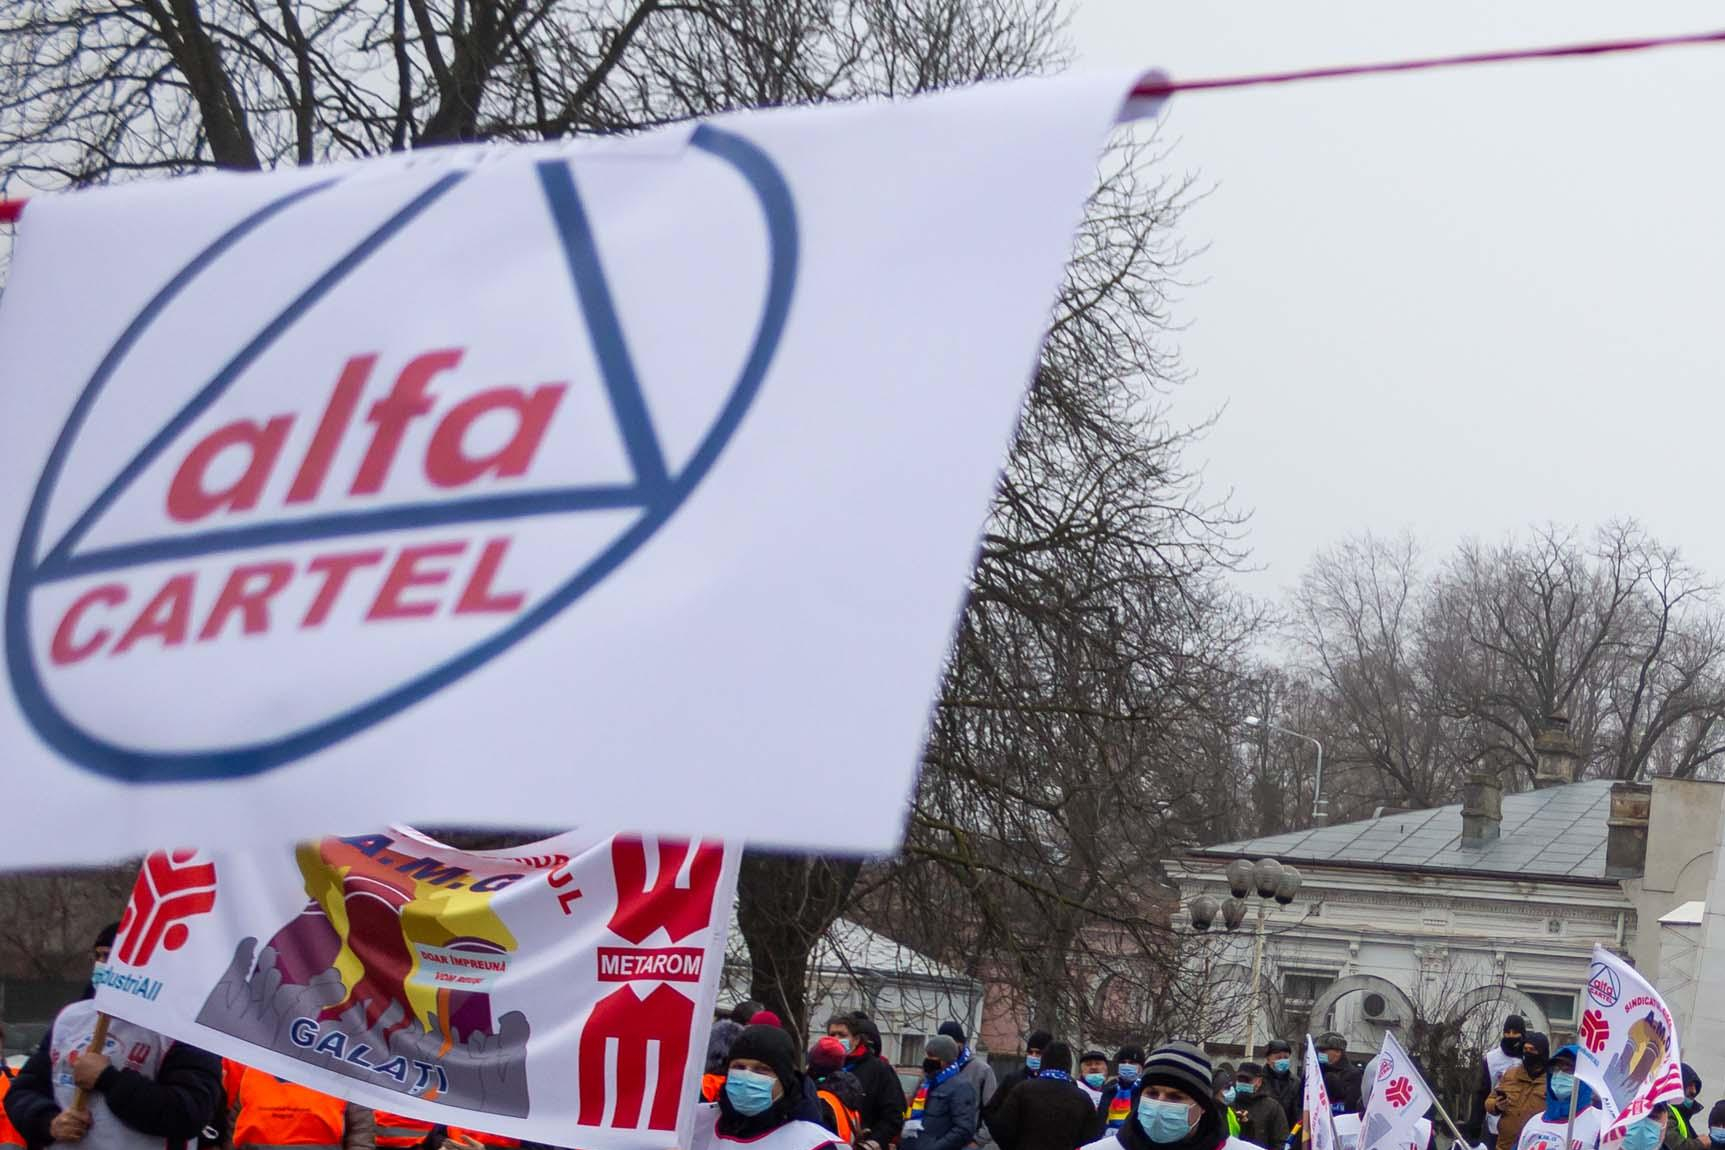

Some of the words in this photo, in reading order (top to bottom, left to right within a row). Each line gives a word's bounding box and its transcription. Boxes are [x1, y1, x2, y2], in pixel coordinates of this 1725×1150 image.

[163, 347, 572, 525] alfa
[49, 536, 531, 667] CARTEL
[602, 954, 701, 976] METAROM
[289, 1018, 449, 1095] GALAȚI
